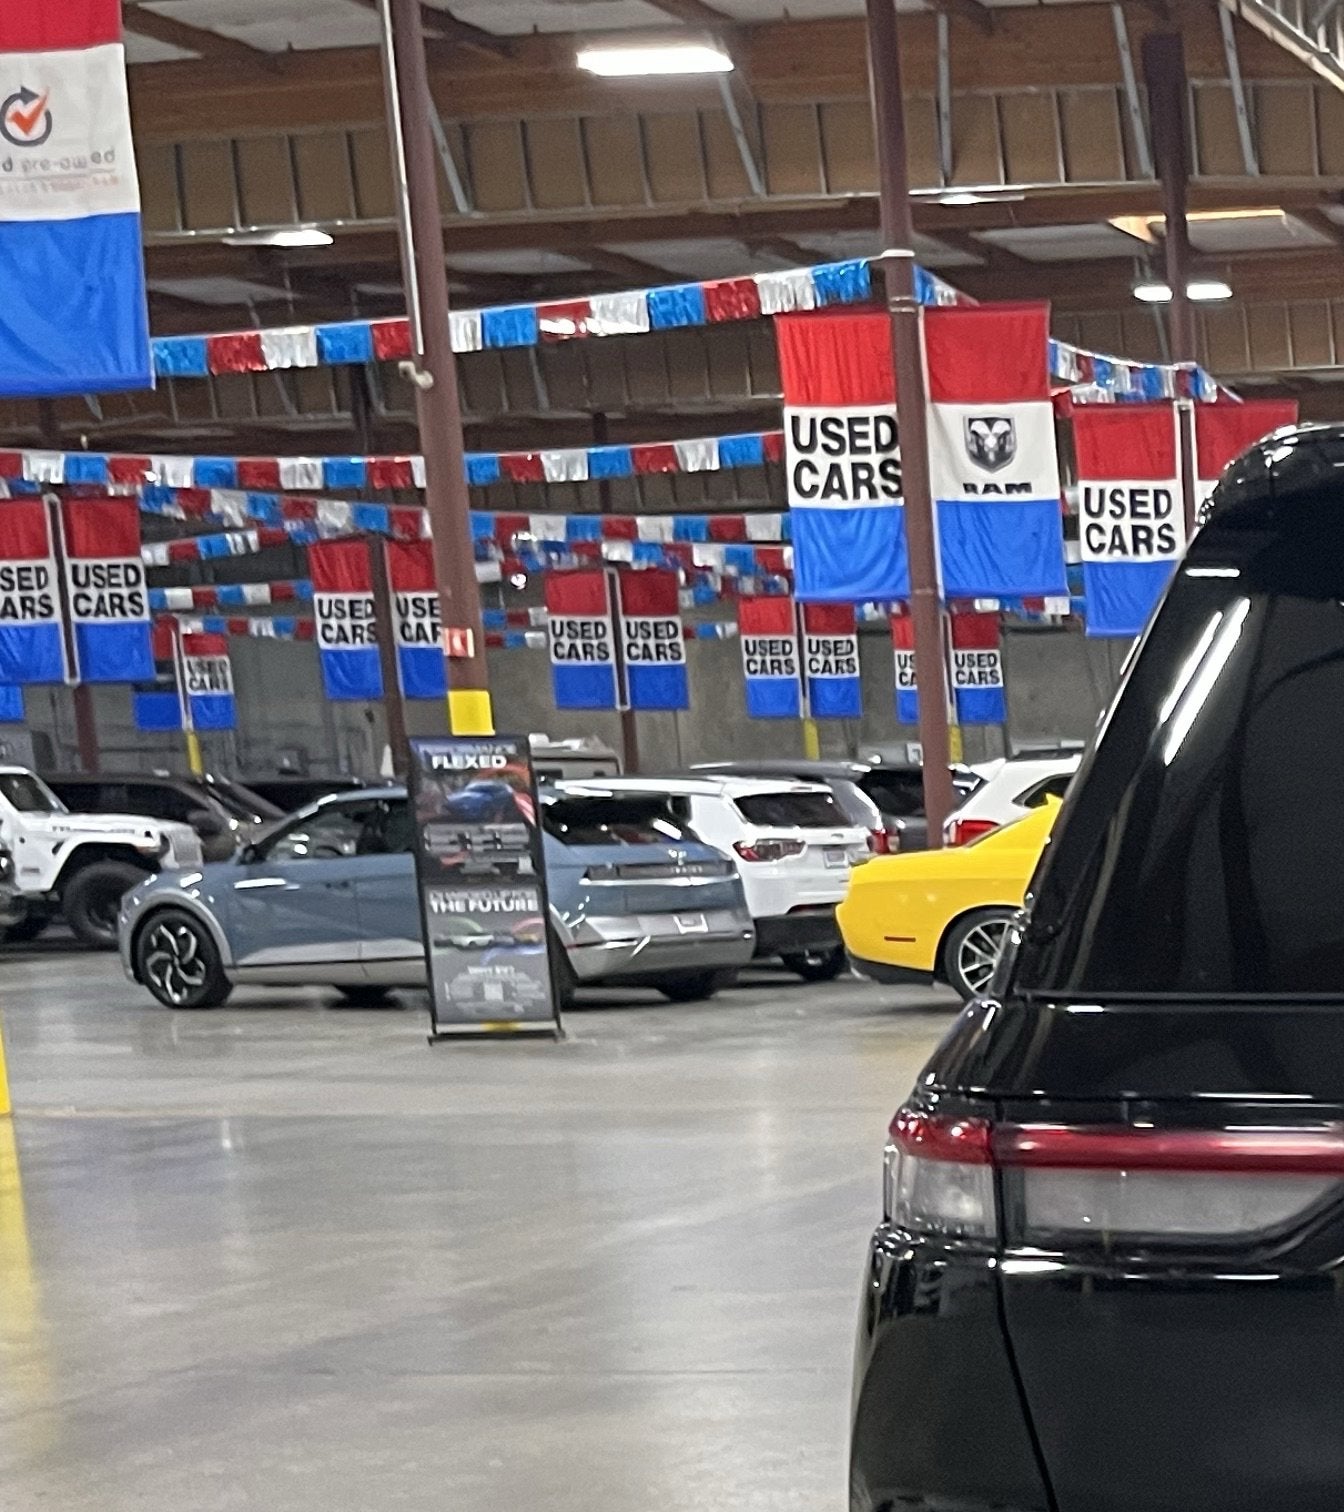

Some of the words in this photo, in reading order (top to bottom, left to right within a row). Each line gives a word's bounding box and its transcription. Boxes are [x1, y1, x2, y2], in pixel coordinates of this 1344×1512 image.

[791, 415, 899, 456] USED
[793, 458, 902, 500] CARS
[962, 481, 1033, 495] RAM
[1084, 487, 1173, 520] USED
[1085, 522, 1177, 556] CARS
[0, 566, 49, 592] SED
[71, 564, 142, 589] USED
[0, 593, 54, 620] ARS
[73, 592, 145, 618] CARS
[318, 598, 375, 620] USED
[395, 596, 441, 619] USE
[321, 622, 377, 644] CARS
[551, 620, 607, 640] USED
[626, 620, 679, 640] USED
[553, 641, 610, 661] CARS
[626, 642, 682, 661] CARS
[744, 638, 793, 657] USED
[808, 638, 855, 657] USED
[746, 657, 796, 676] CARS
[808, 657, 857, 675] CARS
[954, 652, 998, 670] USED
[955, 669, 1001, 685] CARS
